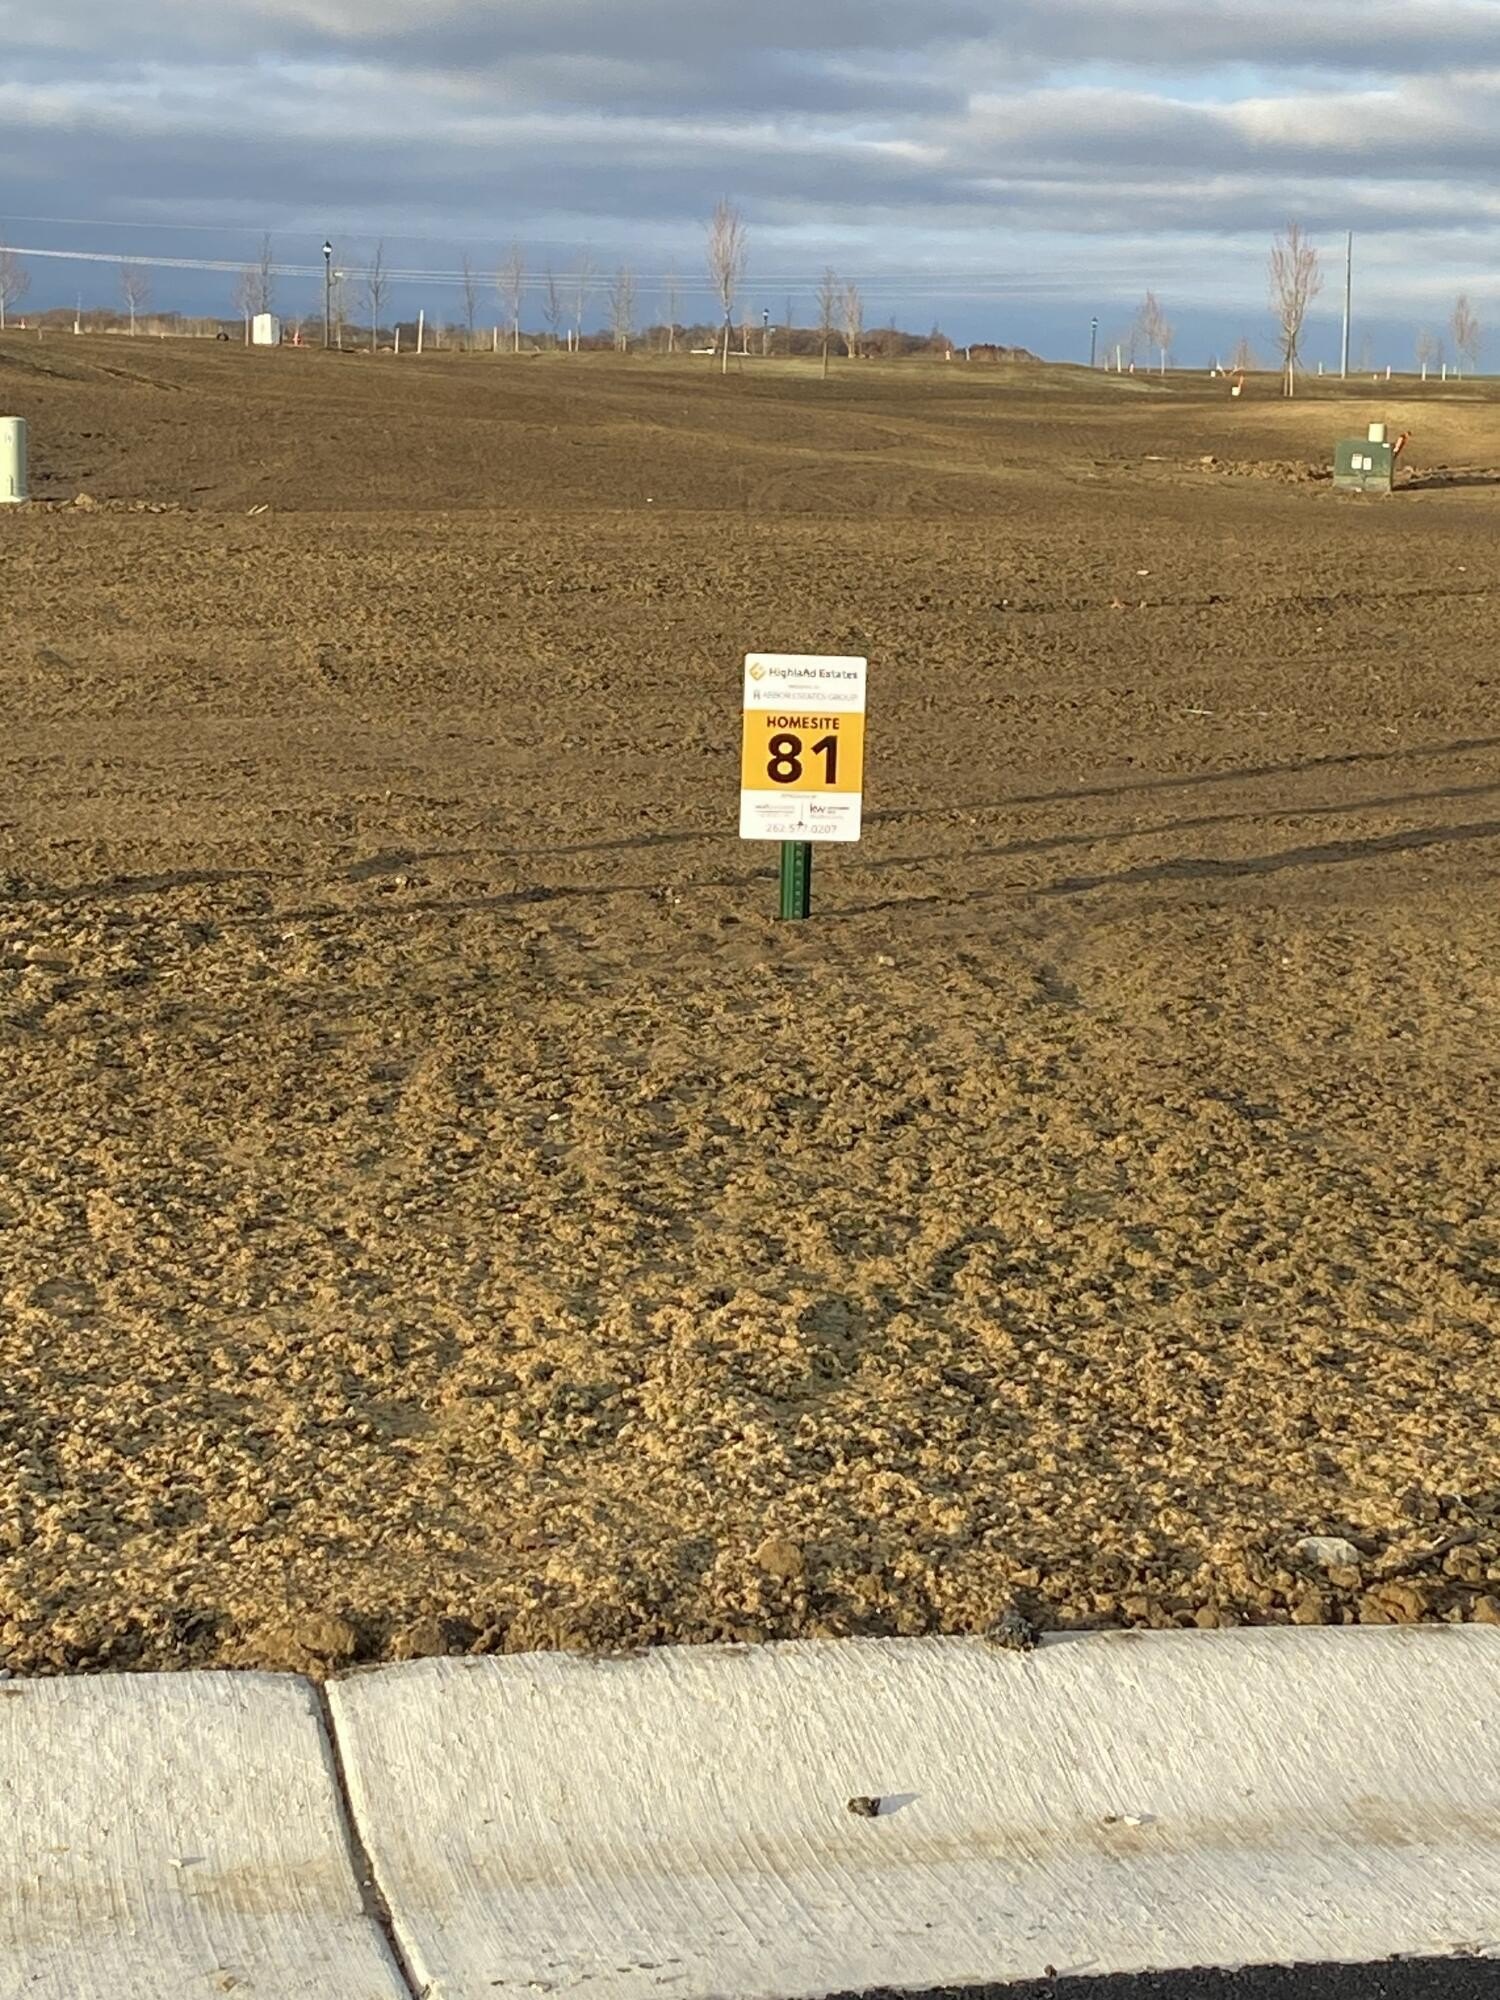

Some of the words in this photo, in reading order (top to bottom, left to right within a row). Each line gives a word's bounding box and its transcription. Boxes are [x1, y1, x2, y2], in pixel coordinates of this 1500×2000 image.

[819, 668, 858, 679] Estates
[766, 715, 840, 730] HOMESITE
[766, 733, 838, 784] 81
[809, 803, 825, 814] kw
